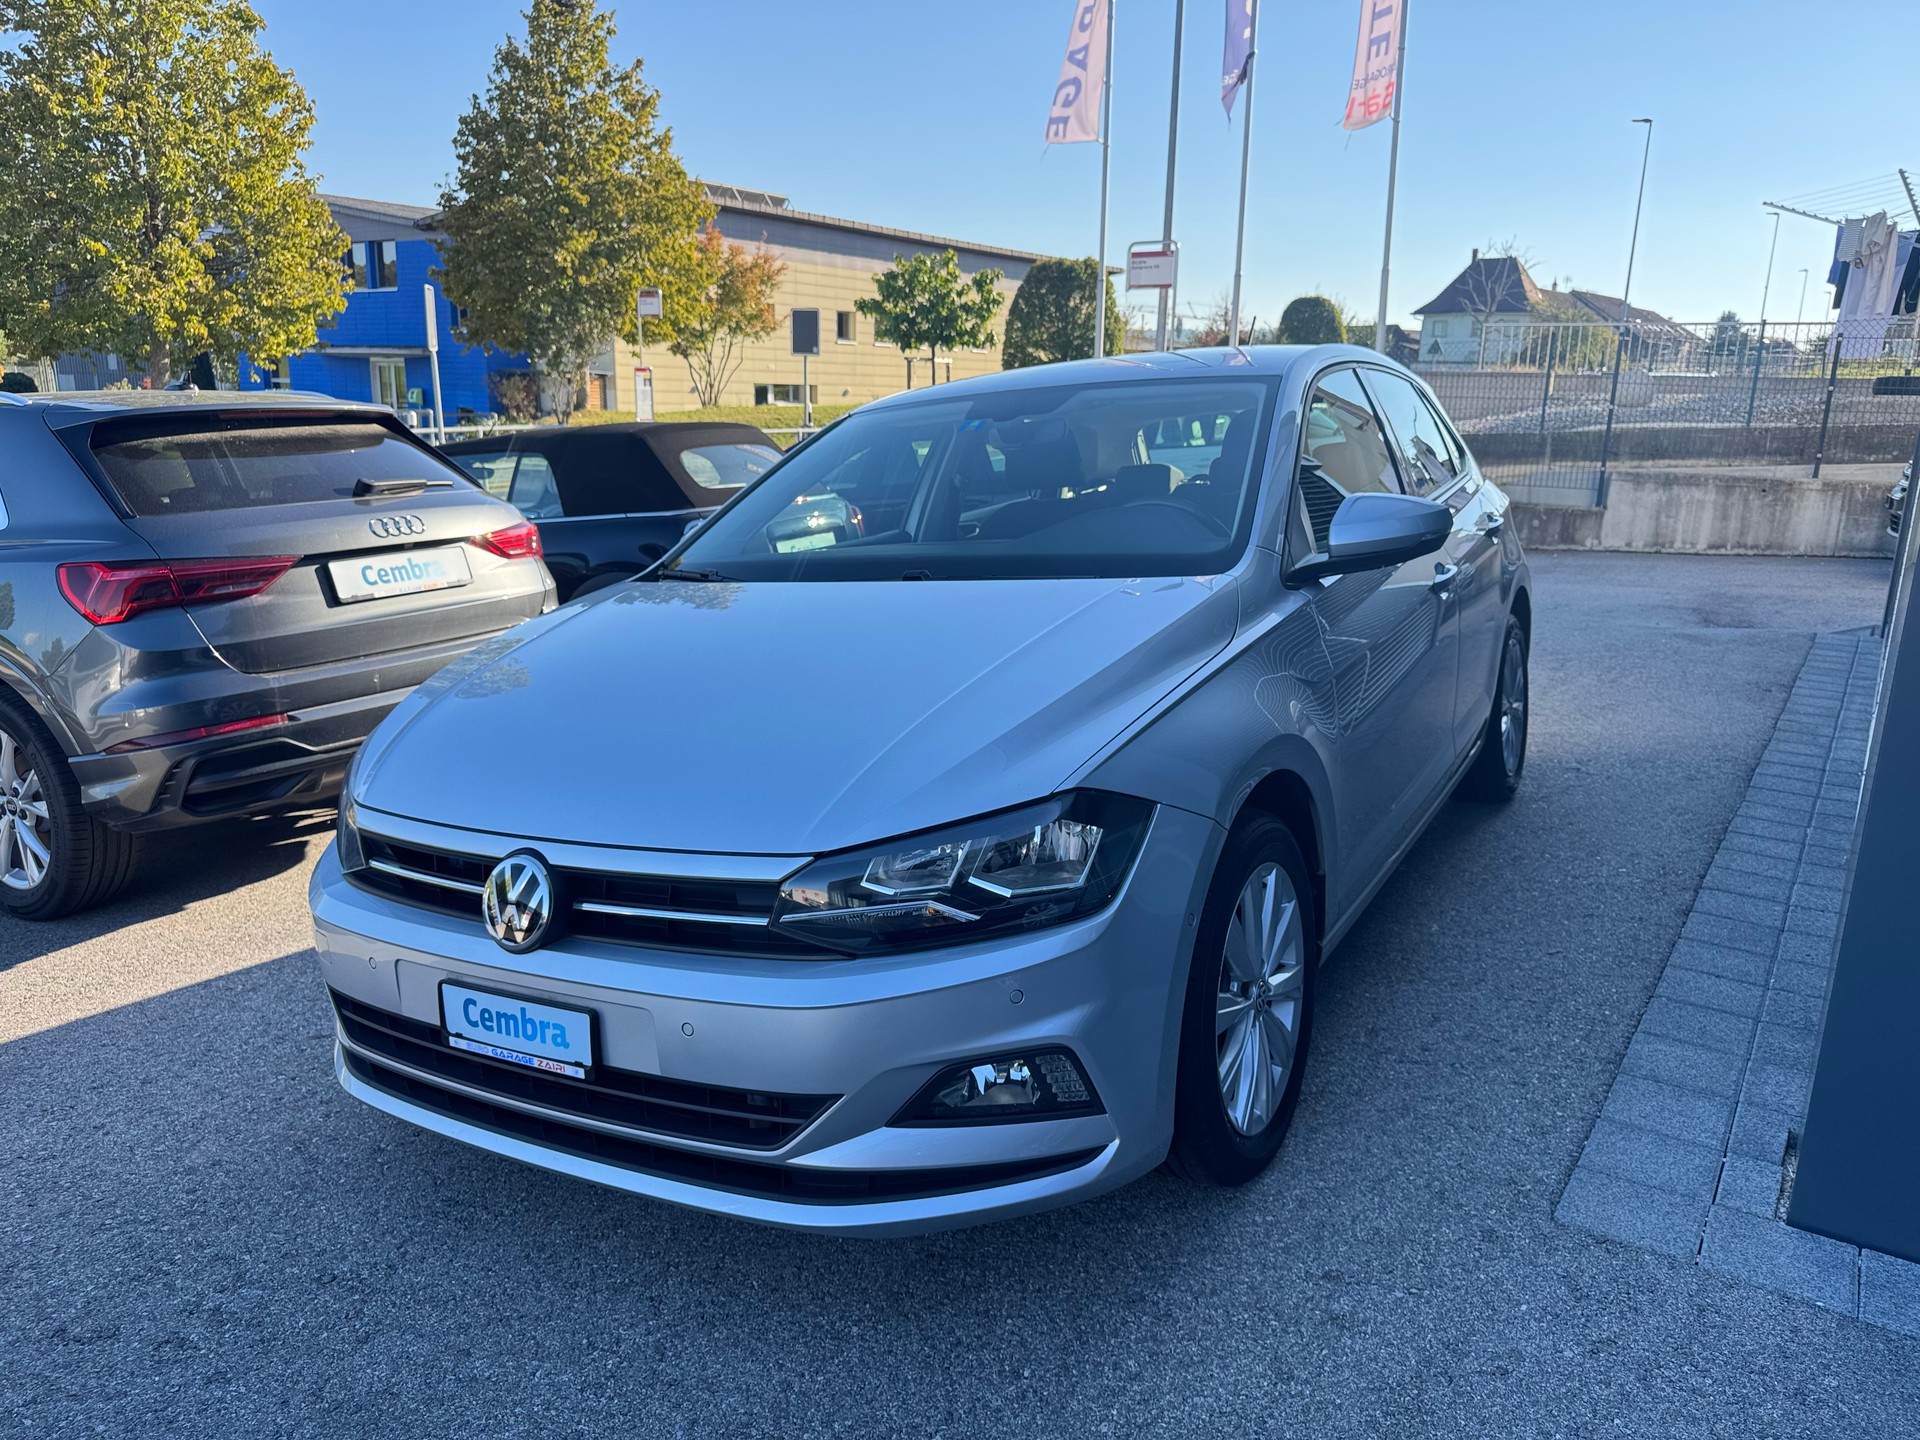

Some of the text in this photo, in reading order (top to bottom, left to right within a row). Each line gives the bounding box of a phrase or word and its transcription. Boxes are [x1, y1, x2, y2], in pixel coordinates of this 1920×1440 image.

[361, 557, 447, 587] Cembra
[463, 997, 570, 1049] Cembra
[465, 1041, 566, 1073] EURO GARAGE ZAIRI
